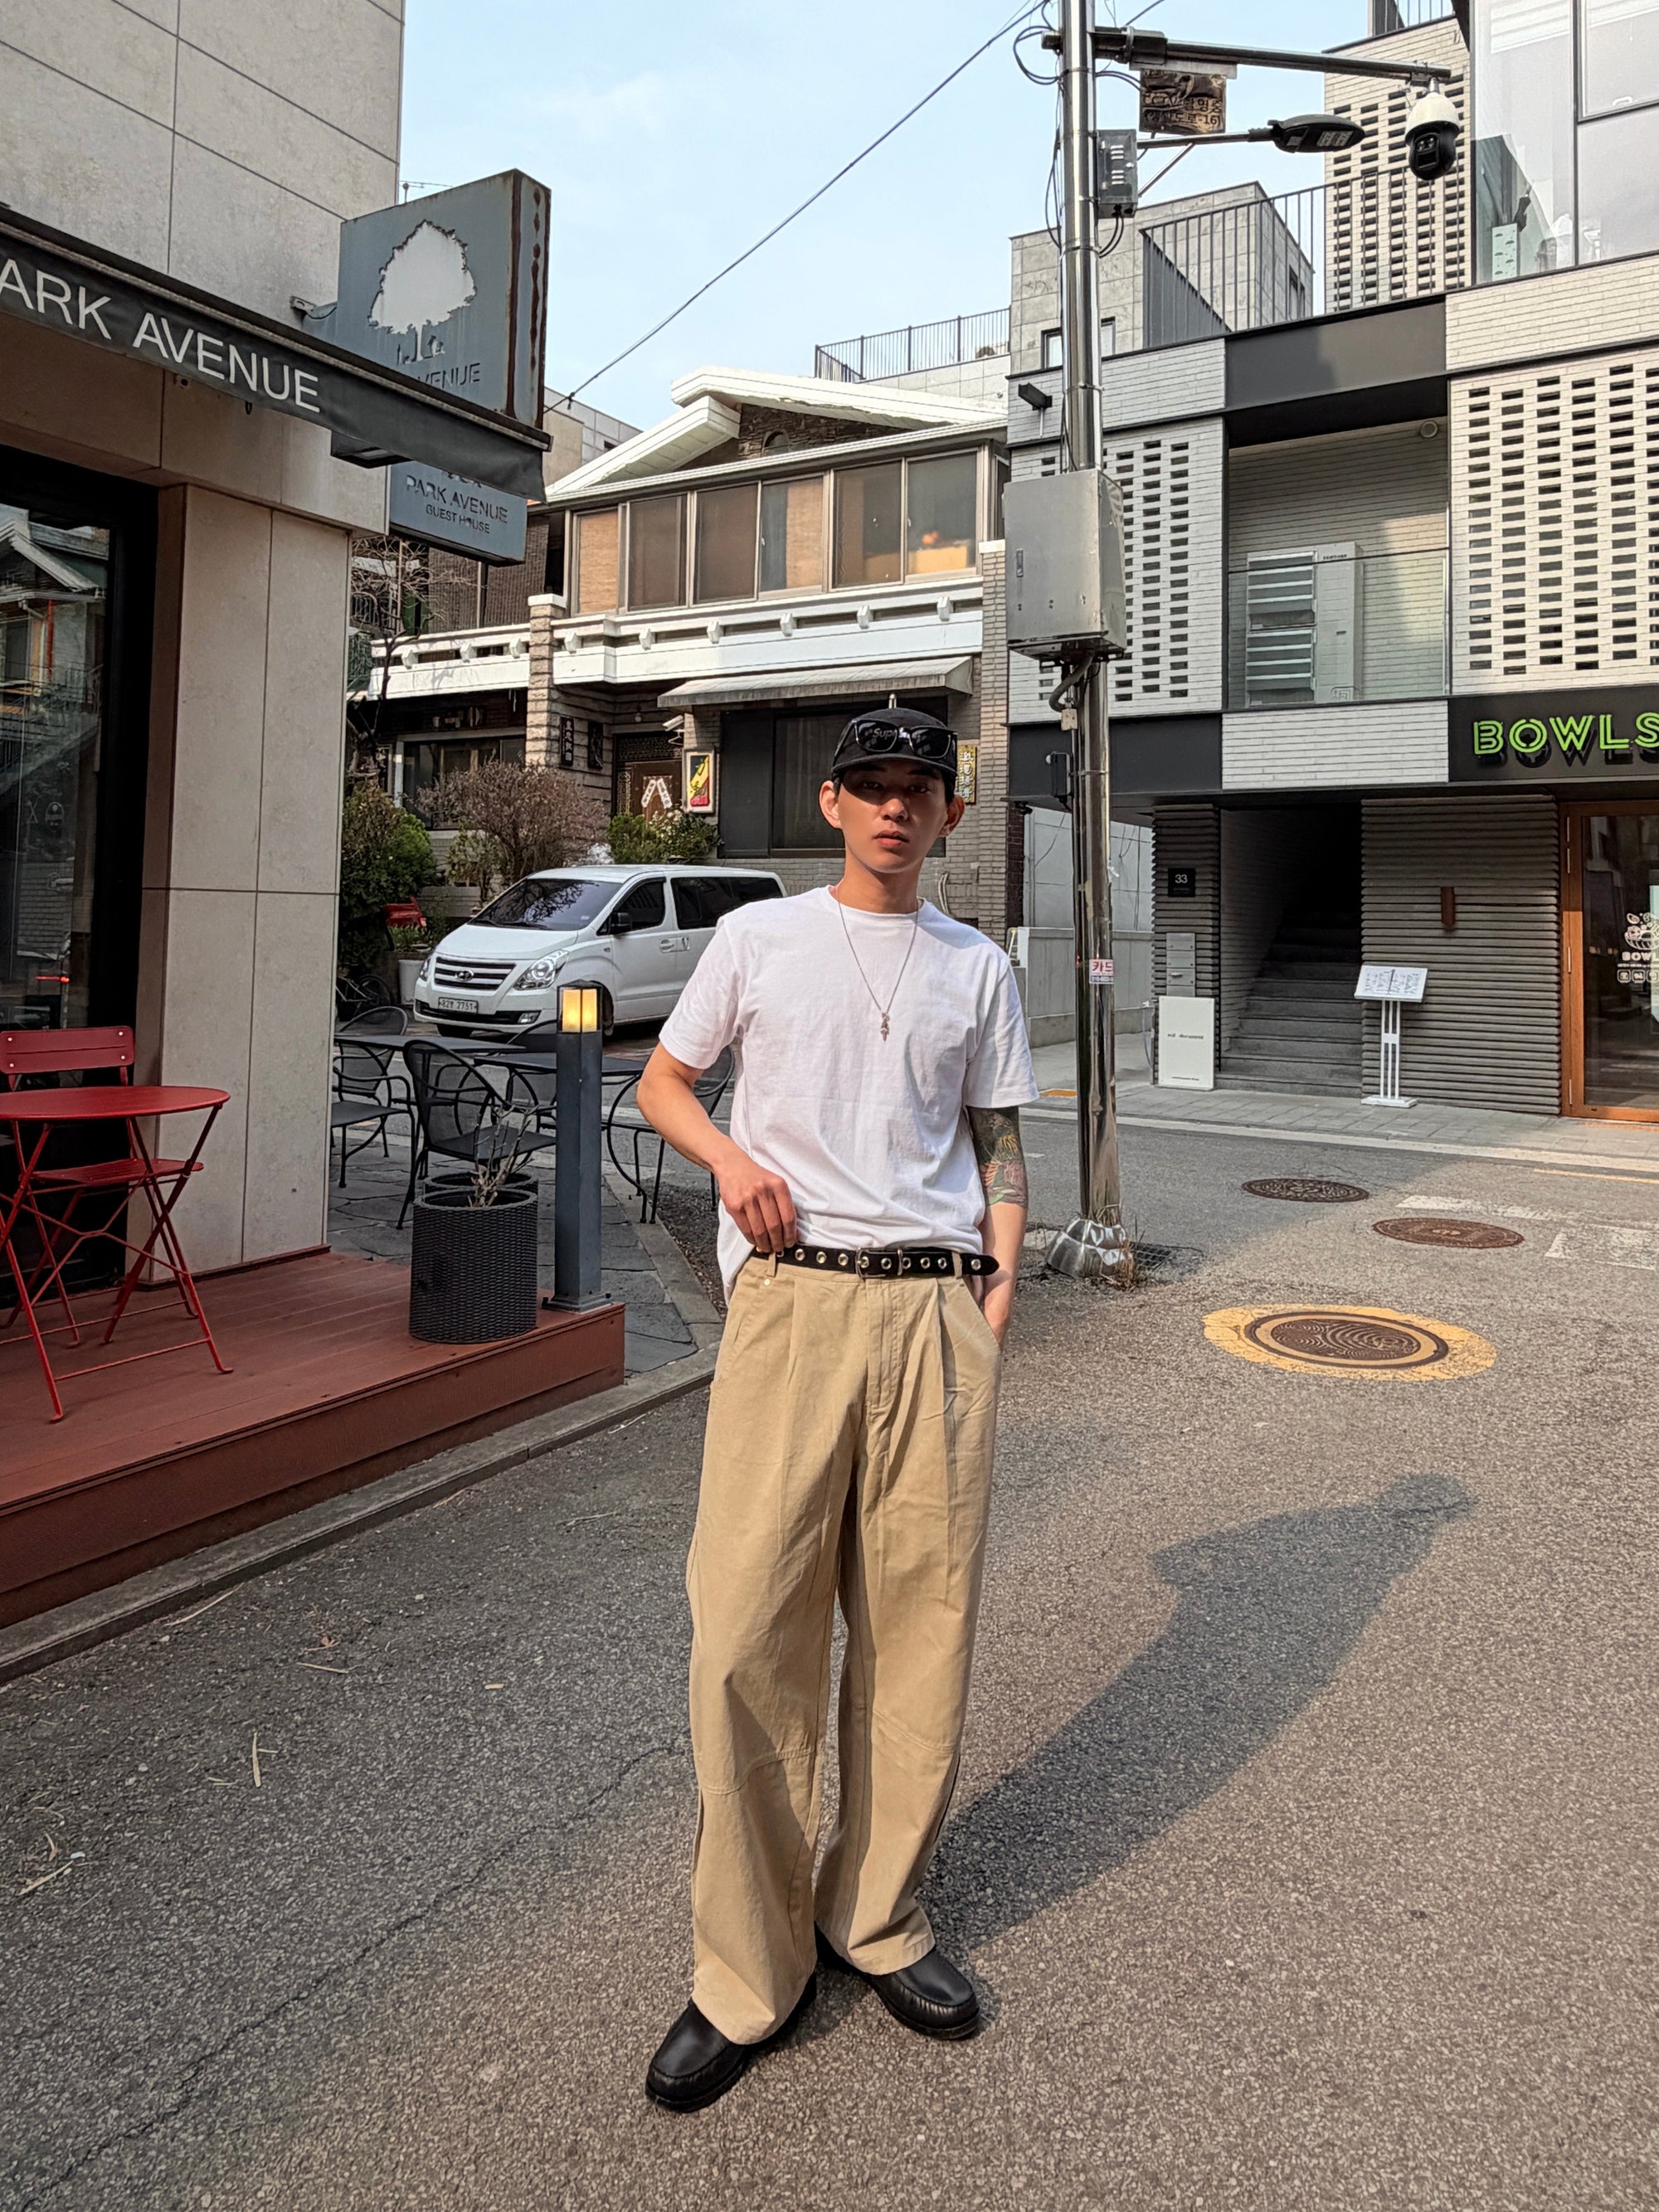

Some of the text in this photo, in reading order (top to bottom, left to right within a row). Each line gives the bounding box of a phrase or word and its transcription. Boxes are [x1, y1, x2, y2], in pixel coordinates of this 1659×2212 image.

[133, 313, 320, 413] AVENUE
[406, 474, 508, 523] PARK AVENUE
[426, 504, 490, 533] GUEST HOUSE
[1473, 712, 1659, 755] BOWLS
[1175, 873, 1188, 884] 33
